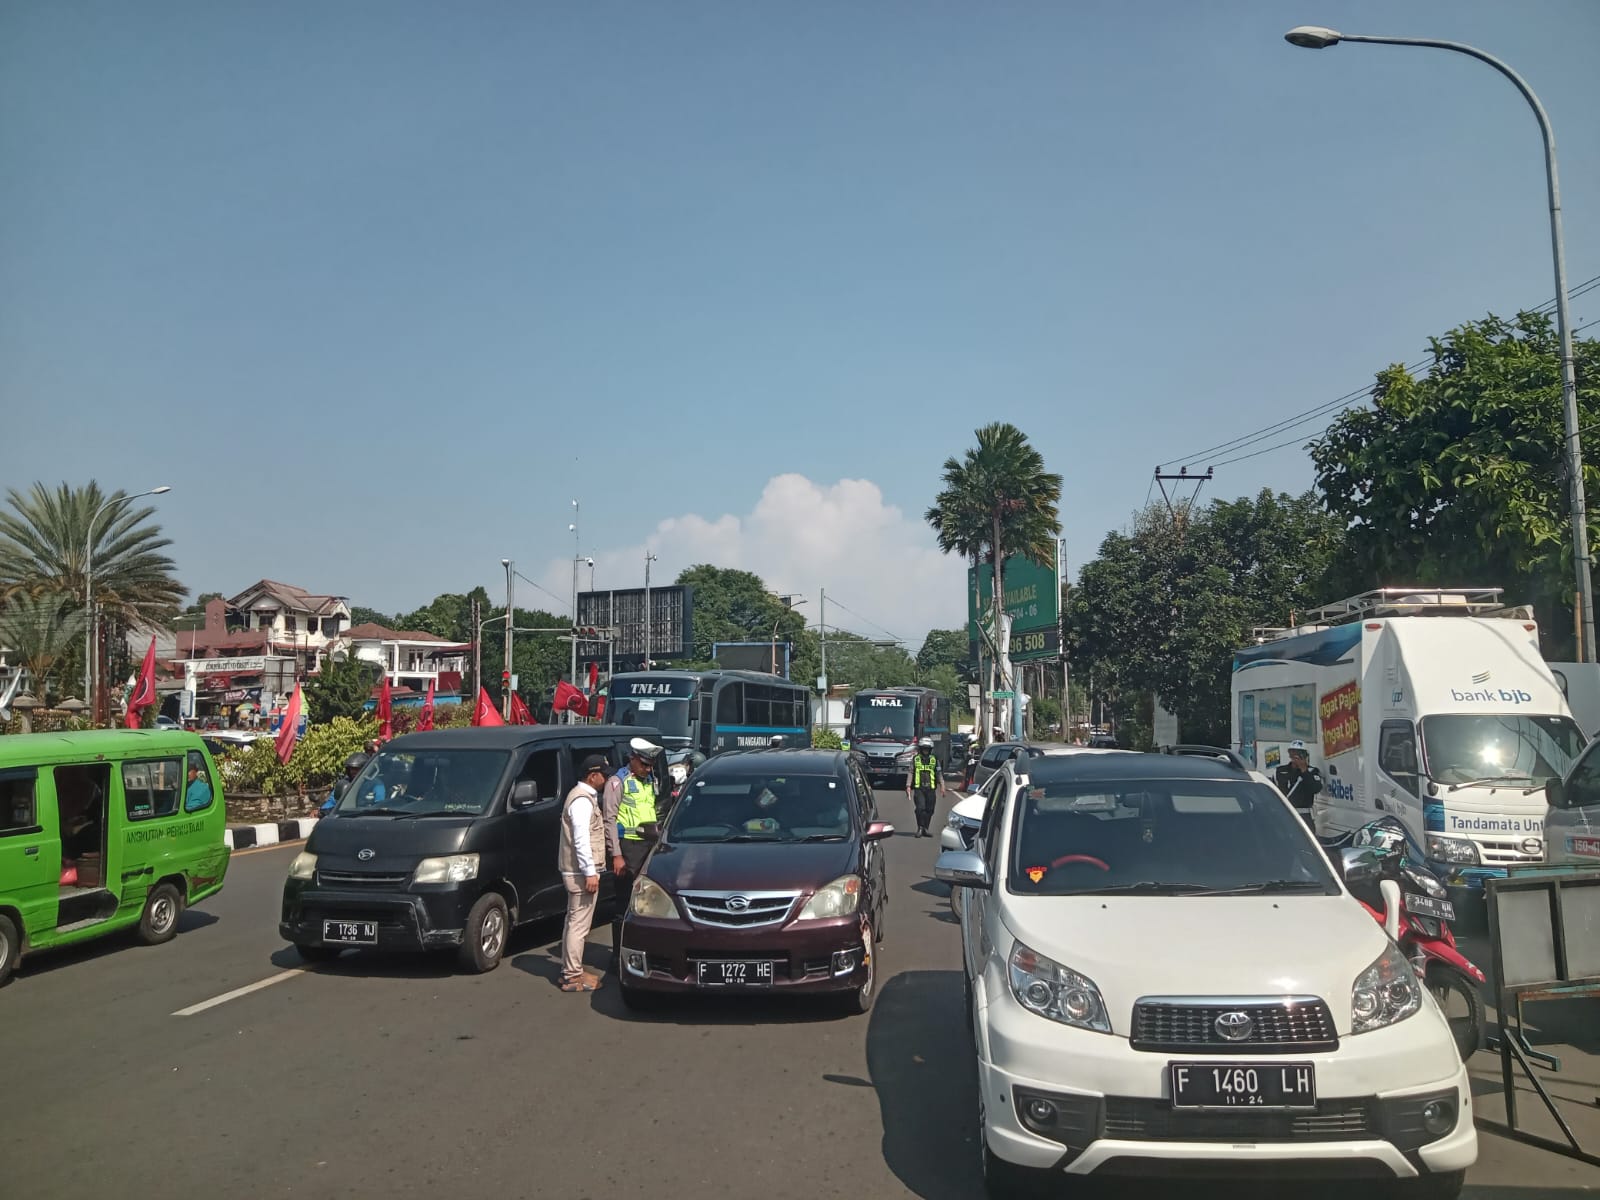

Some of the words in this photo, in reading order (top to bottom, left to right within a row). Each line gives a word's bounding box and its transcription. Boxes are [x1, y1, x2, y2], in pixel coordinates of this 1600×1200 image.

[1025, 633, 1045, 651] 508
[630, 683, 672, 695] TNI-AL
[1451, 688, 1497, 702] bank
[1498, 689, 1532, 704] bjb
[870, 699, 903, 707] TNI-AL
[1340, 687, 1362, 710] Pajak
[1324, 724, 1344, 745] Ingat
[1345, 716, 1358, 738] bjb
[745, 736, 767, 747] ANGKATAN
[1450, 816, 1520, 831] Tandamata
[1523, 819, 1544, 832] Unt
[126, 829, 164, 844] ANGKUTAN
[325, 922, 330, 934] F
[339, 923, 358, 936] 1736
[364, 924, 375, 936] NJ
[700, 963, 707, 977] F
[721, 963, 746, 977] 1272
[757, 963, 771, 977] HE
[1177, 1068, 1189, 1093] F
[1212, 1068, 1259, 1093] 1460
[1281, 1068, 1309, 1093] LH
